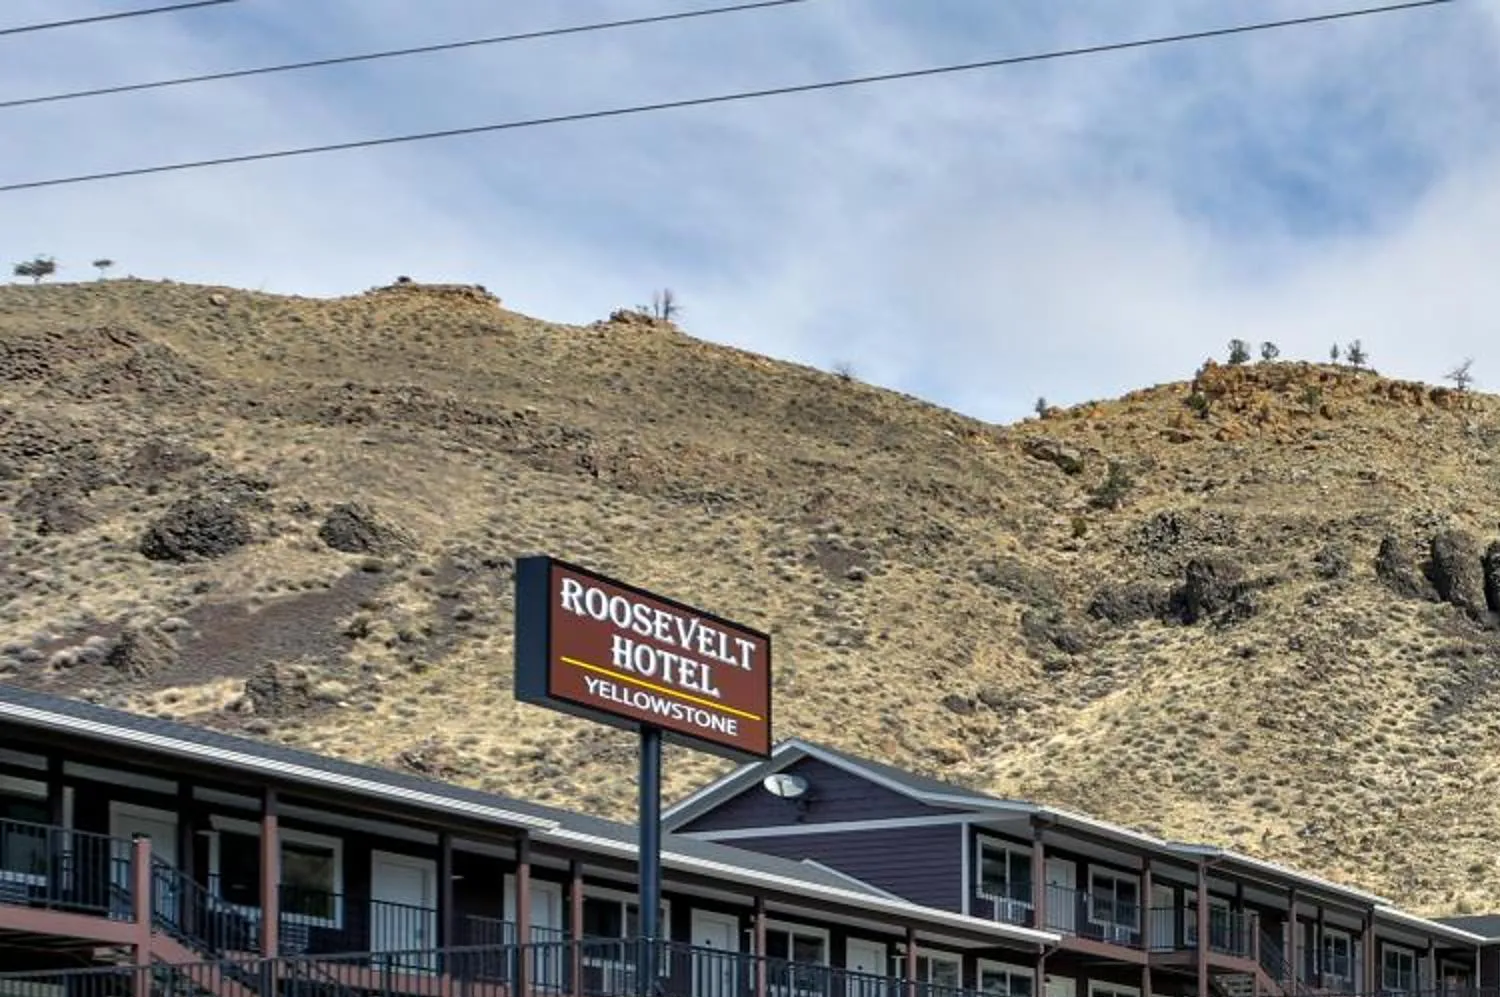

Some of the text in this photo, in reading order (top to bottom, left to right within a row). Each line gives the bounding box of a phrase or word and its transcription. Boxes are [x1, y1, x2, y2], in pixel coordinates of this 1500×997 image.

[560, 577, 756, 671] ROOSEVELT
[611, 635, 721, 699] HOTEL
[584, 675, 738, 736] YELLOWSTONE
